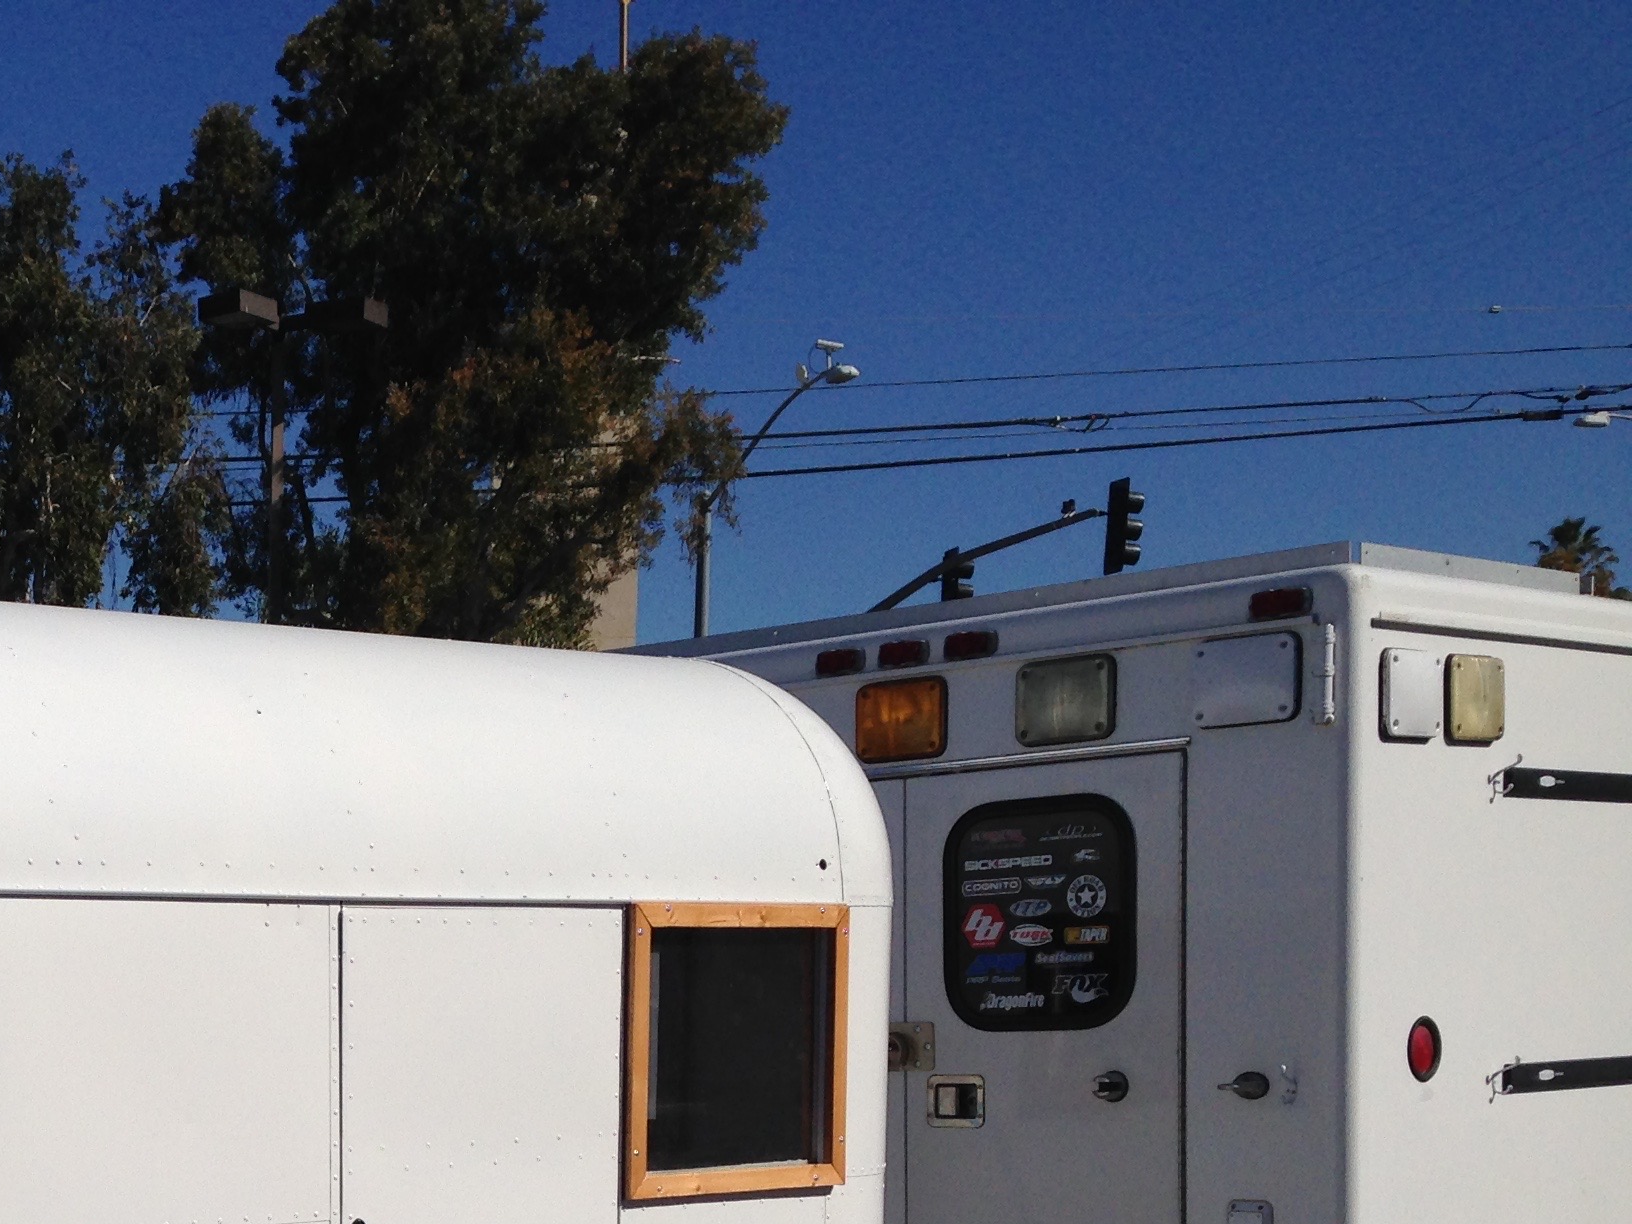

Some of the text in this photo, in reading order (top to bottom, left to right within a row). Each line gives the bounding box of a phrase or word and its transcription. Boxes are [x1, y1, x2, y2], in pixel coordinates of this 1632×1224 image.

[964, 854, 1053, 872] SICKSPEED
[964, 880, 1019, 893] COGNITO
[1051, 973, 1110, 1003] FOX
